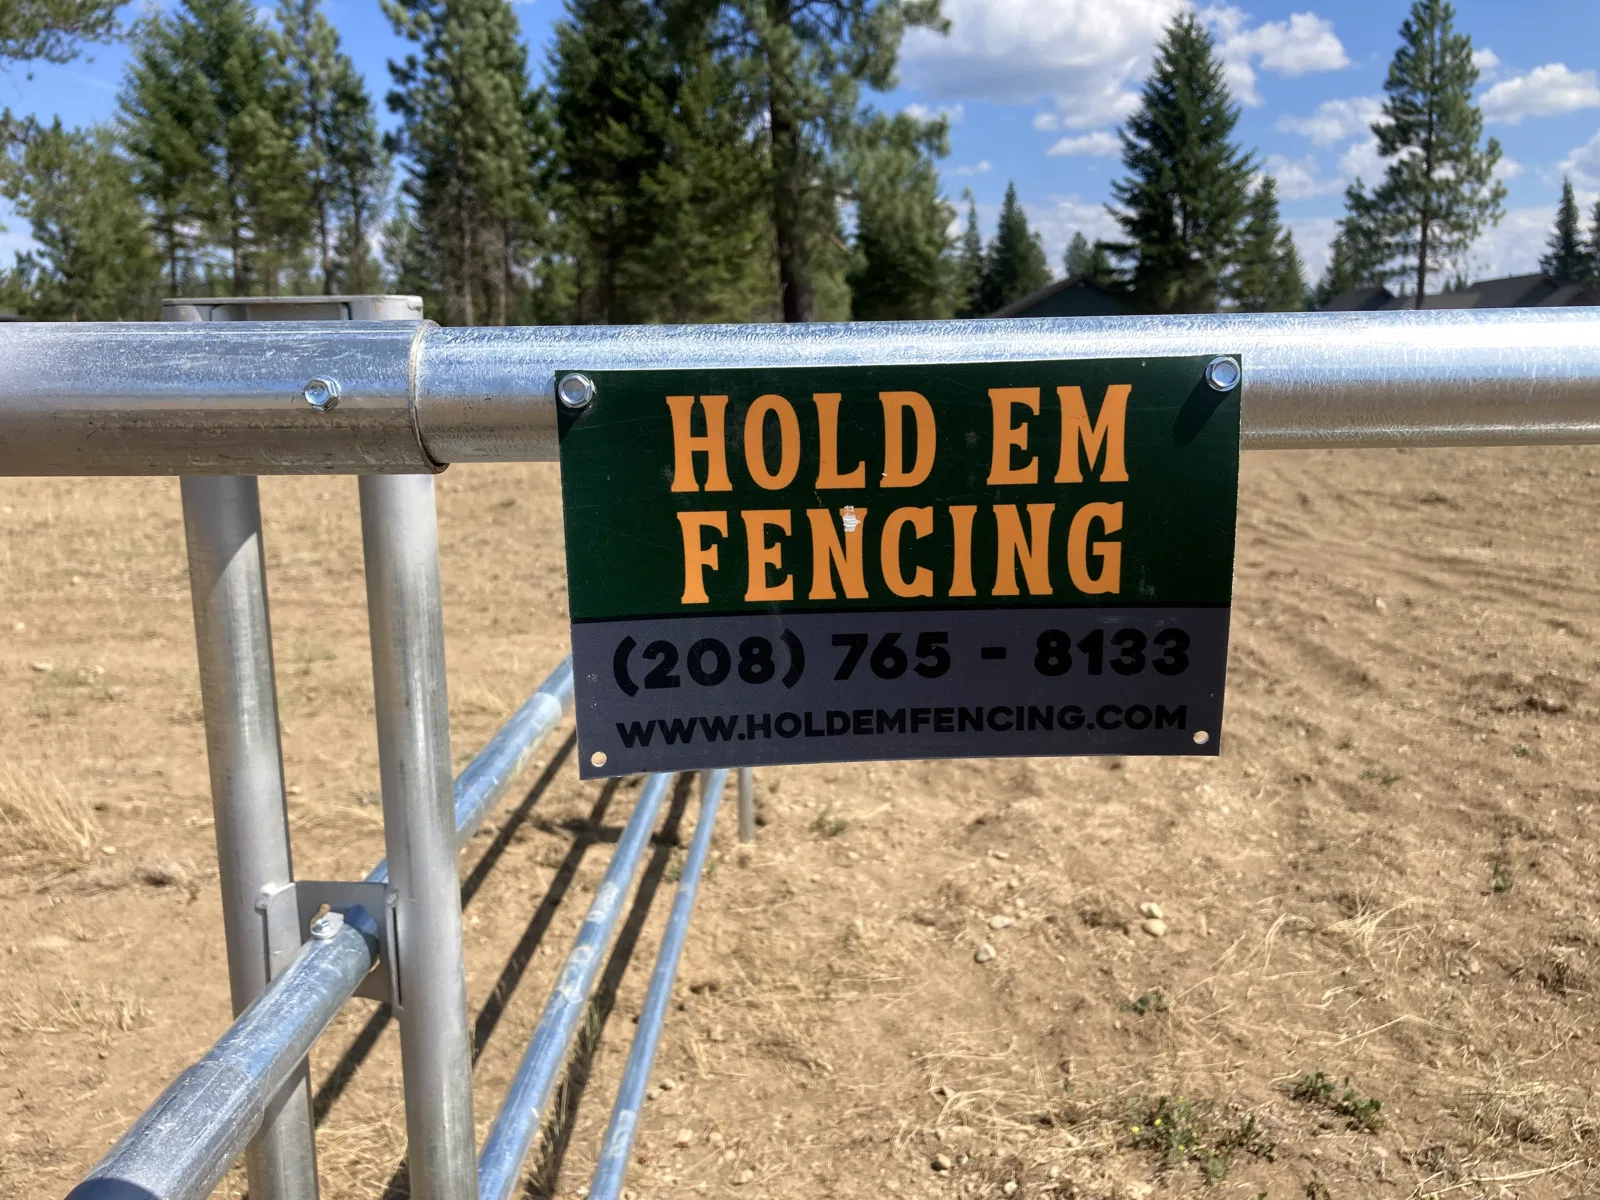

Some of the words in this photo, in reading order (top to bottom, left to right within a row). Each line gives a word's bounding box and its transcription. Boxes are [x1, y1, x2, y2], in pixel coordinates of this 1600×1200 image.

[665, 390, 936, 493] HOLD
[987, 383, 1132, 485] EM
[677, 501, 1124, 605] FENCING
[613, 629, 805, 697] (208)
[832, 631, 951, 682] 765
[981, 646, 1007, 660] -
[1034, 628, 1192, 678] 8133
[615, 704, 1188, 749] WWW.HOLDEMFENCING.COM
